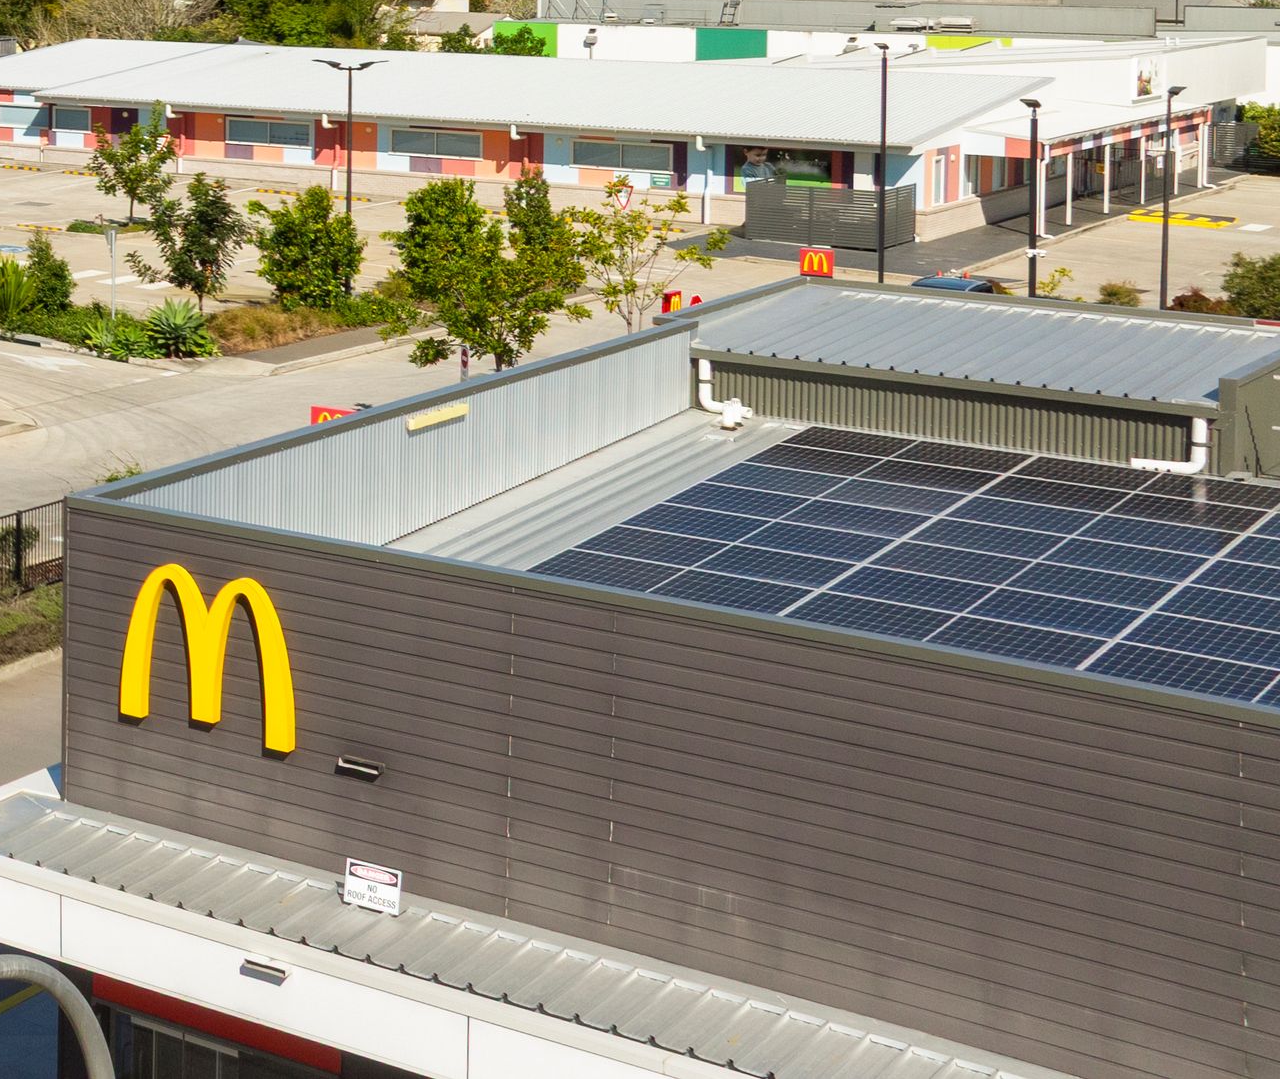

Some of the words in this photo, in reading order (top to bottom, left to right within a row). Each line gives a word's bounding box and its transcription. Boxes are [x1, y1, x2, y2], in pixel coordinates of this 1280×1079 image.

[367, 884, 378, 894] NO
[347, 889, 367, 901] ROOF
[368, 895, 396, 910] ACCESS
